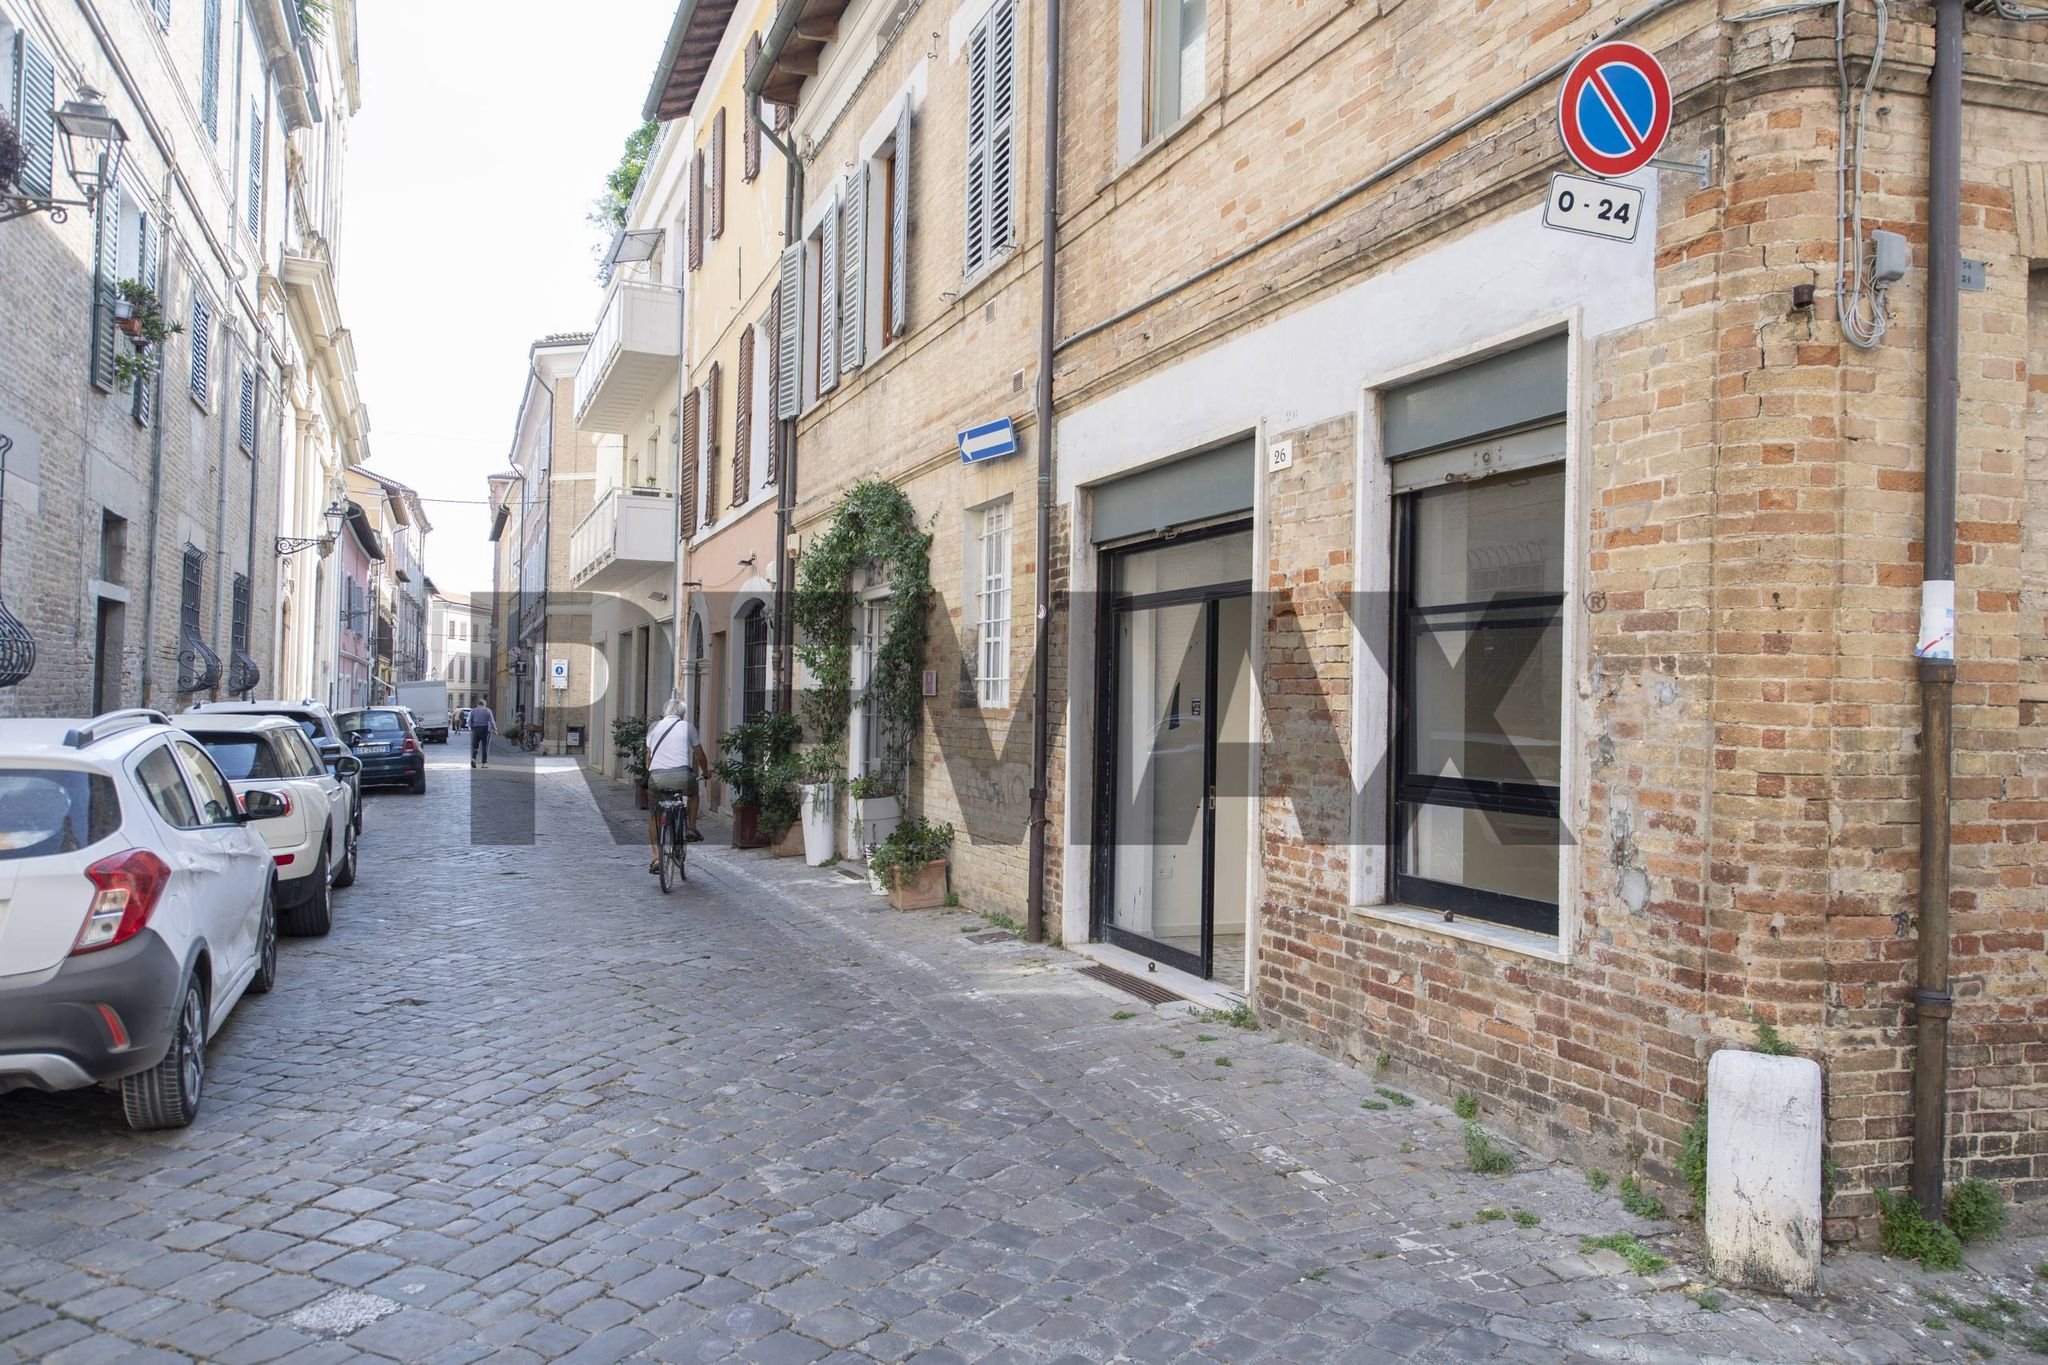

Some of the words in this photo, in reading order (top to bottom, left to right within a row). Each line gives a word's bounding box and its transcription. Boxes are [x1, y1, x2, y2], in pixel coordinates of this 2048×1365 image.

[1558, 190, 1575, 213] 0
[1597, 199, 1630, 224] 24
[1274, 448, 1286, 464] 26
